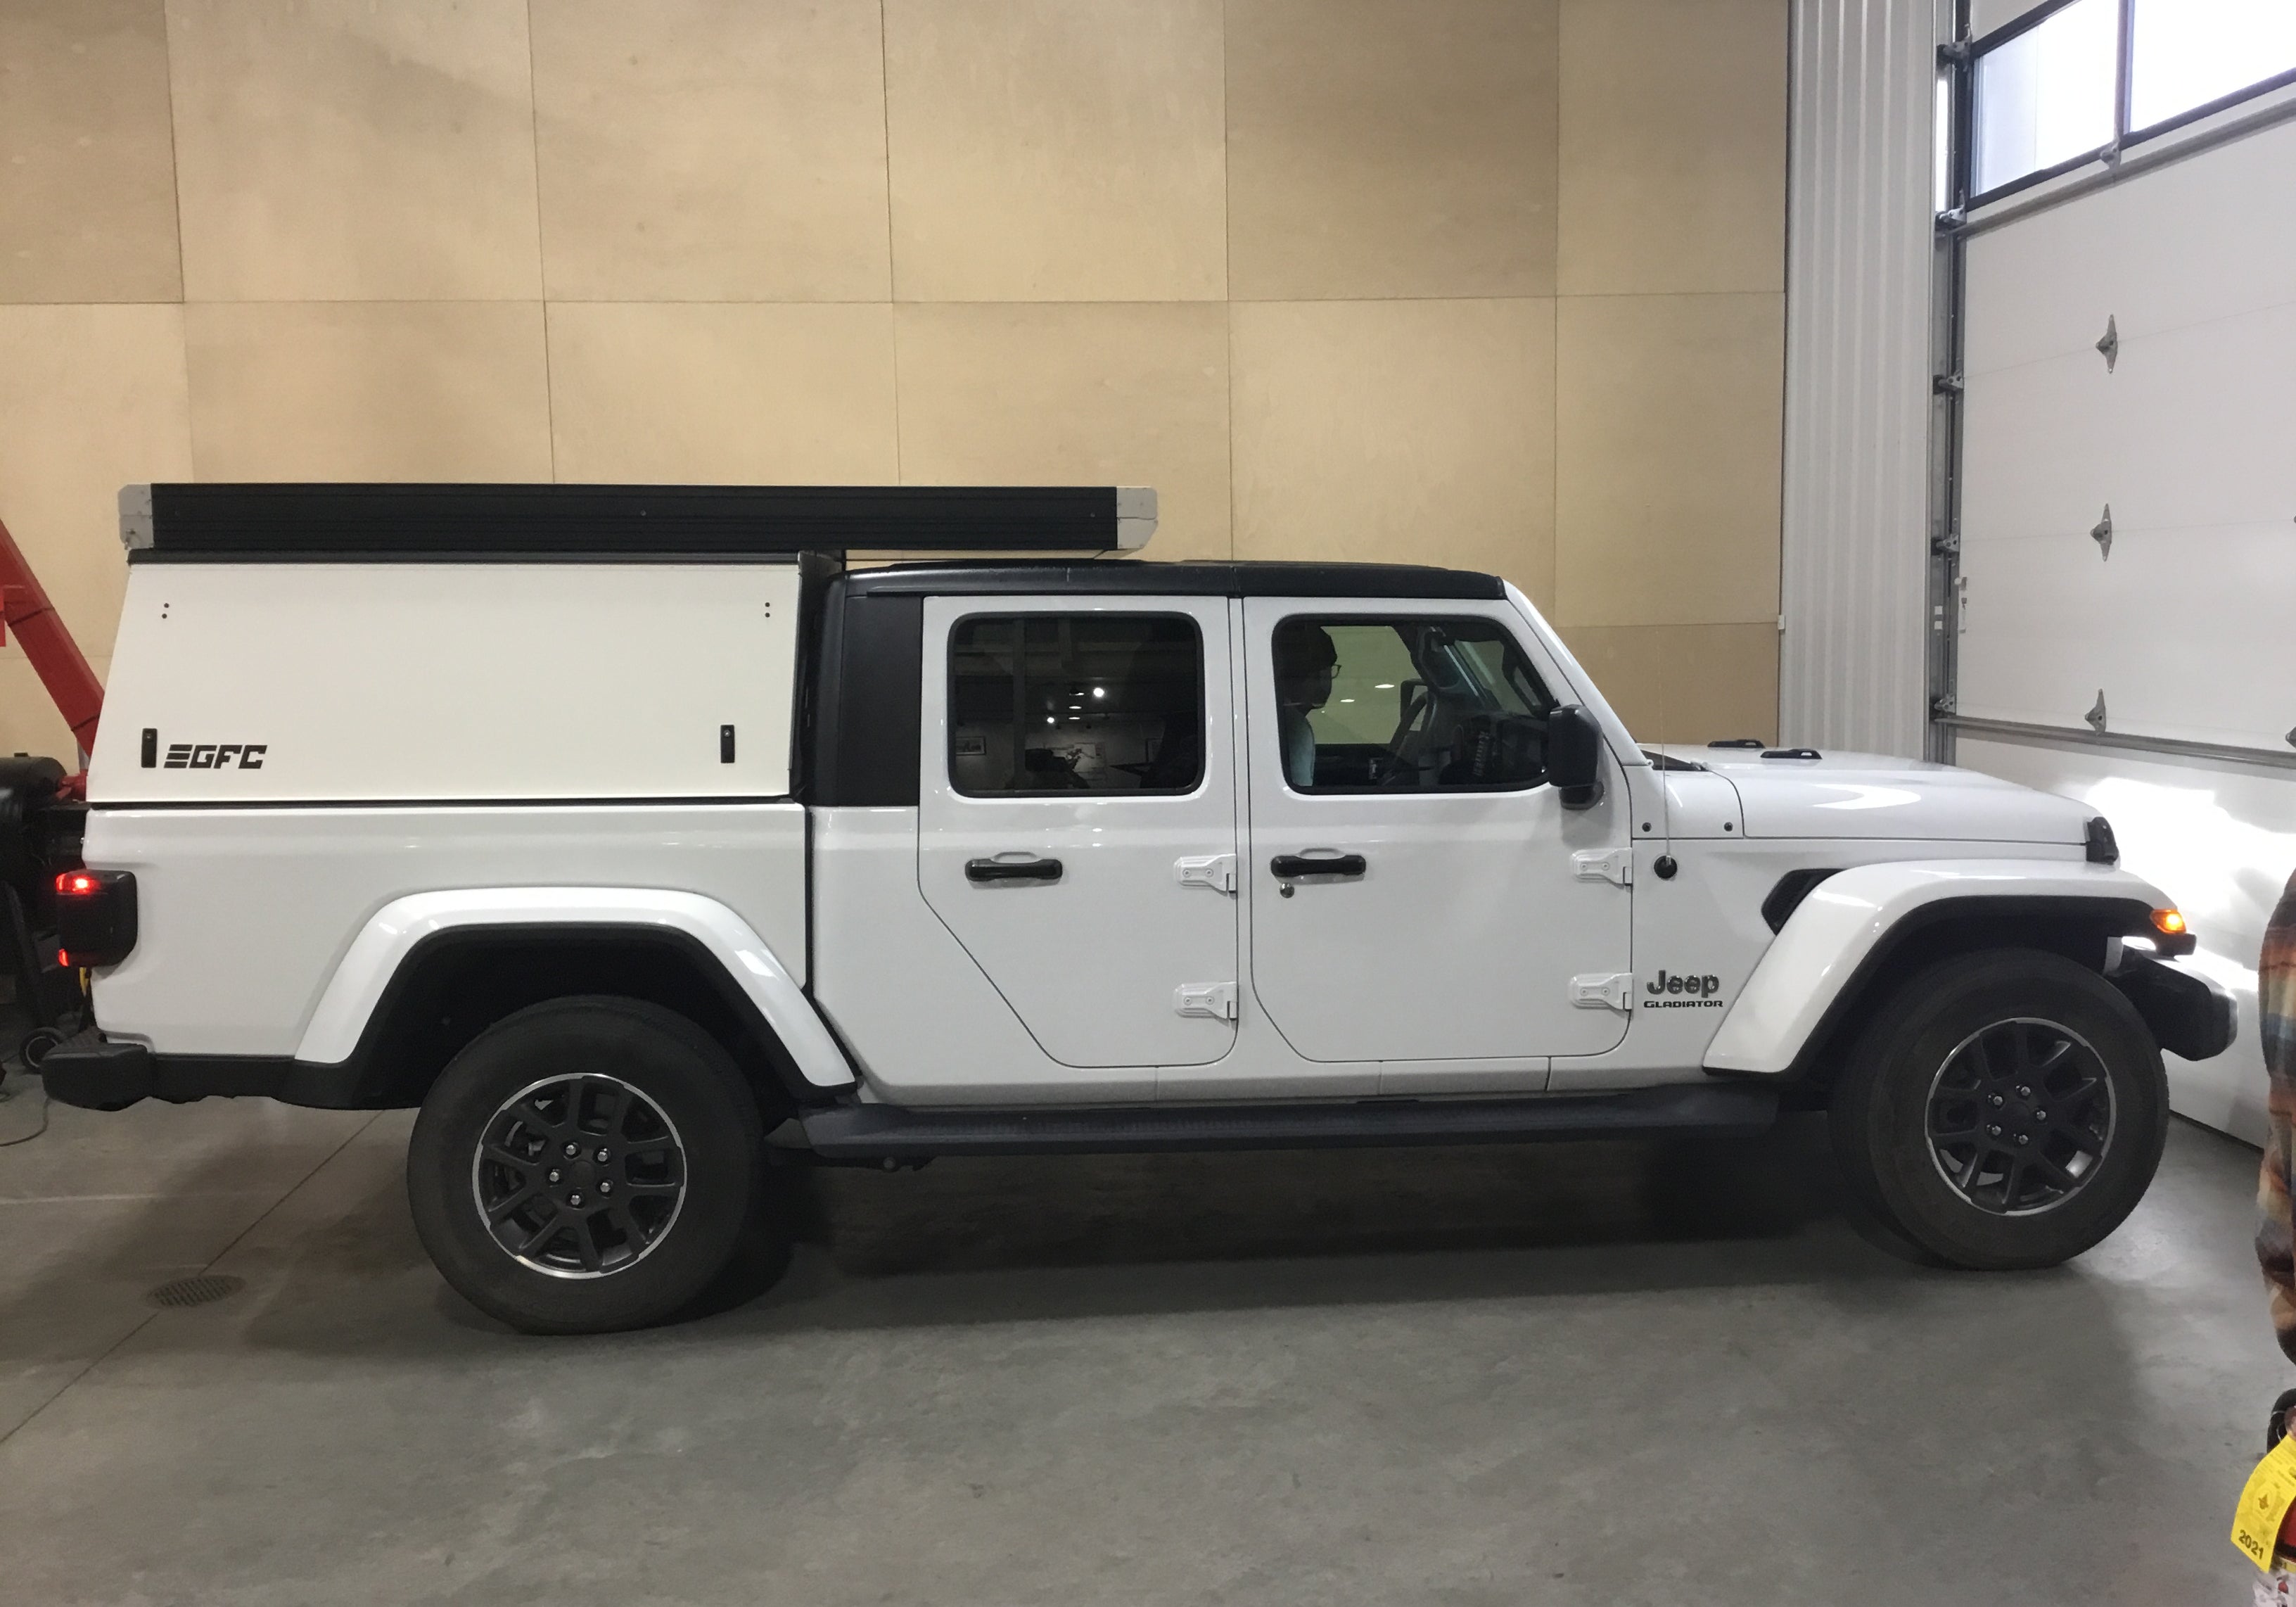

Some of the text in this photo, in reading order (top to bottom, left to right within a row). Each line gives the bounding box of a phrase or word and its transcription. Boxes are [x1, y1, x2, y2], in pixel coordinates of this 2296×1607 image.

[1646, 970, 1719, 998] Jeep
[1643, 1000, 1723, 1008] GLADIATOR
[2238, 1529, 2264, 1560] 2021
